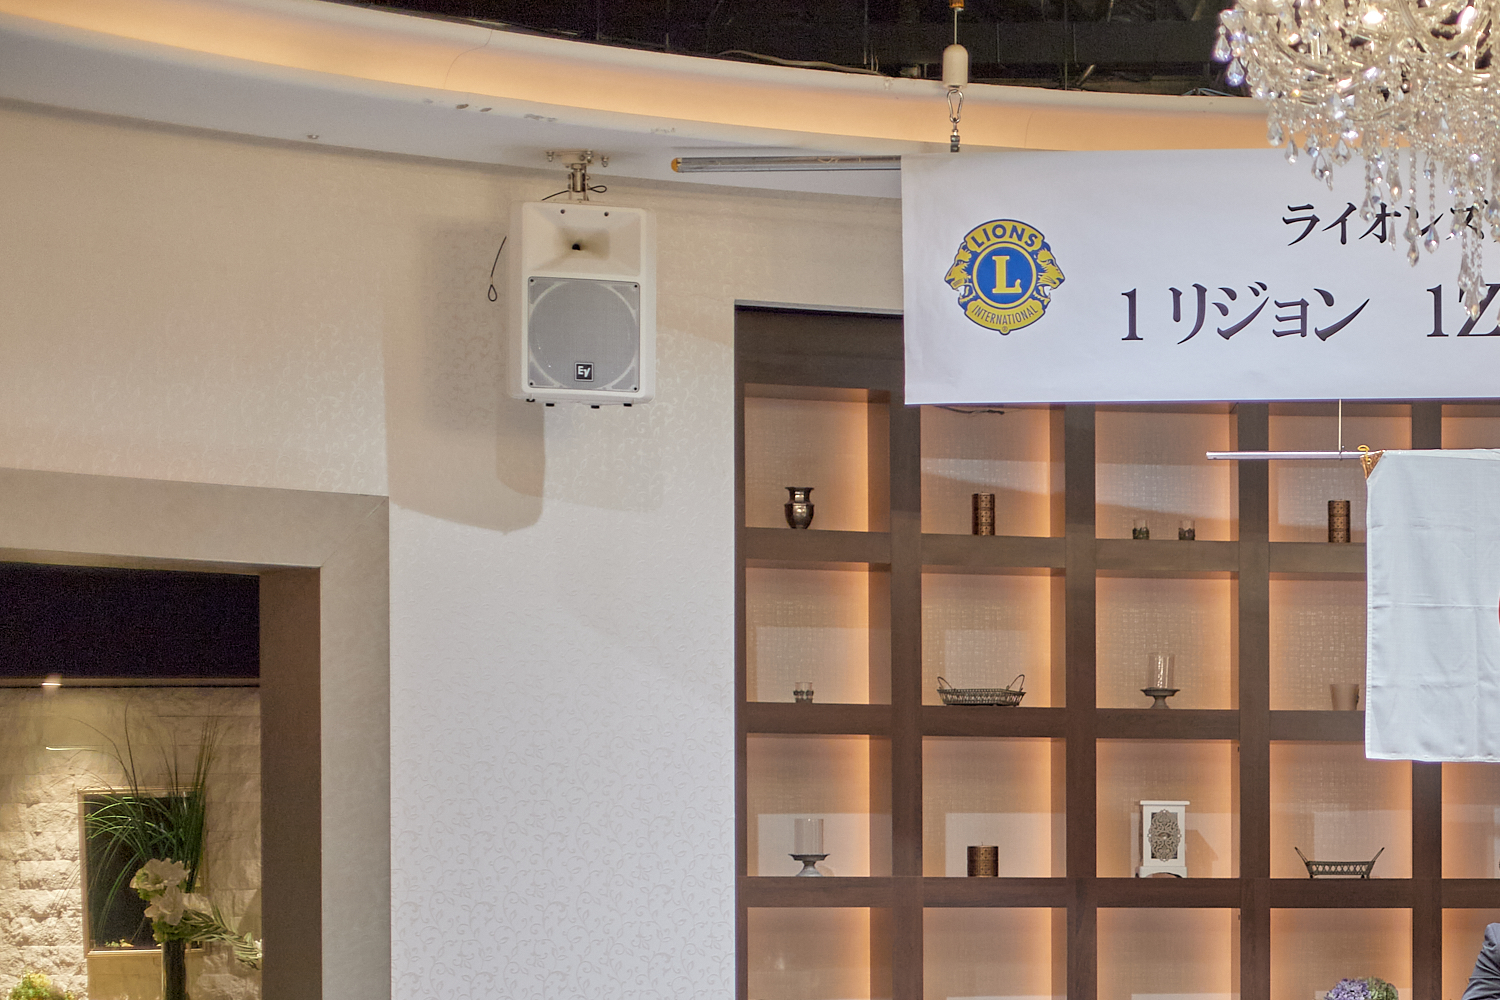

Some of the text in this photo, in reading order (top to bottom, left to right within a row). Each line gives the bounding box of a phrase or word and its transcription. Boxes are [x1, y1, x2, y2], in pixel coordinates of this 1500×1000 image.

[970, 224, 1038, 248] LIONS
[992, 255, 1022, 294] L
[971, 304, 1038, 325] INTERNATIONAL
